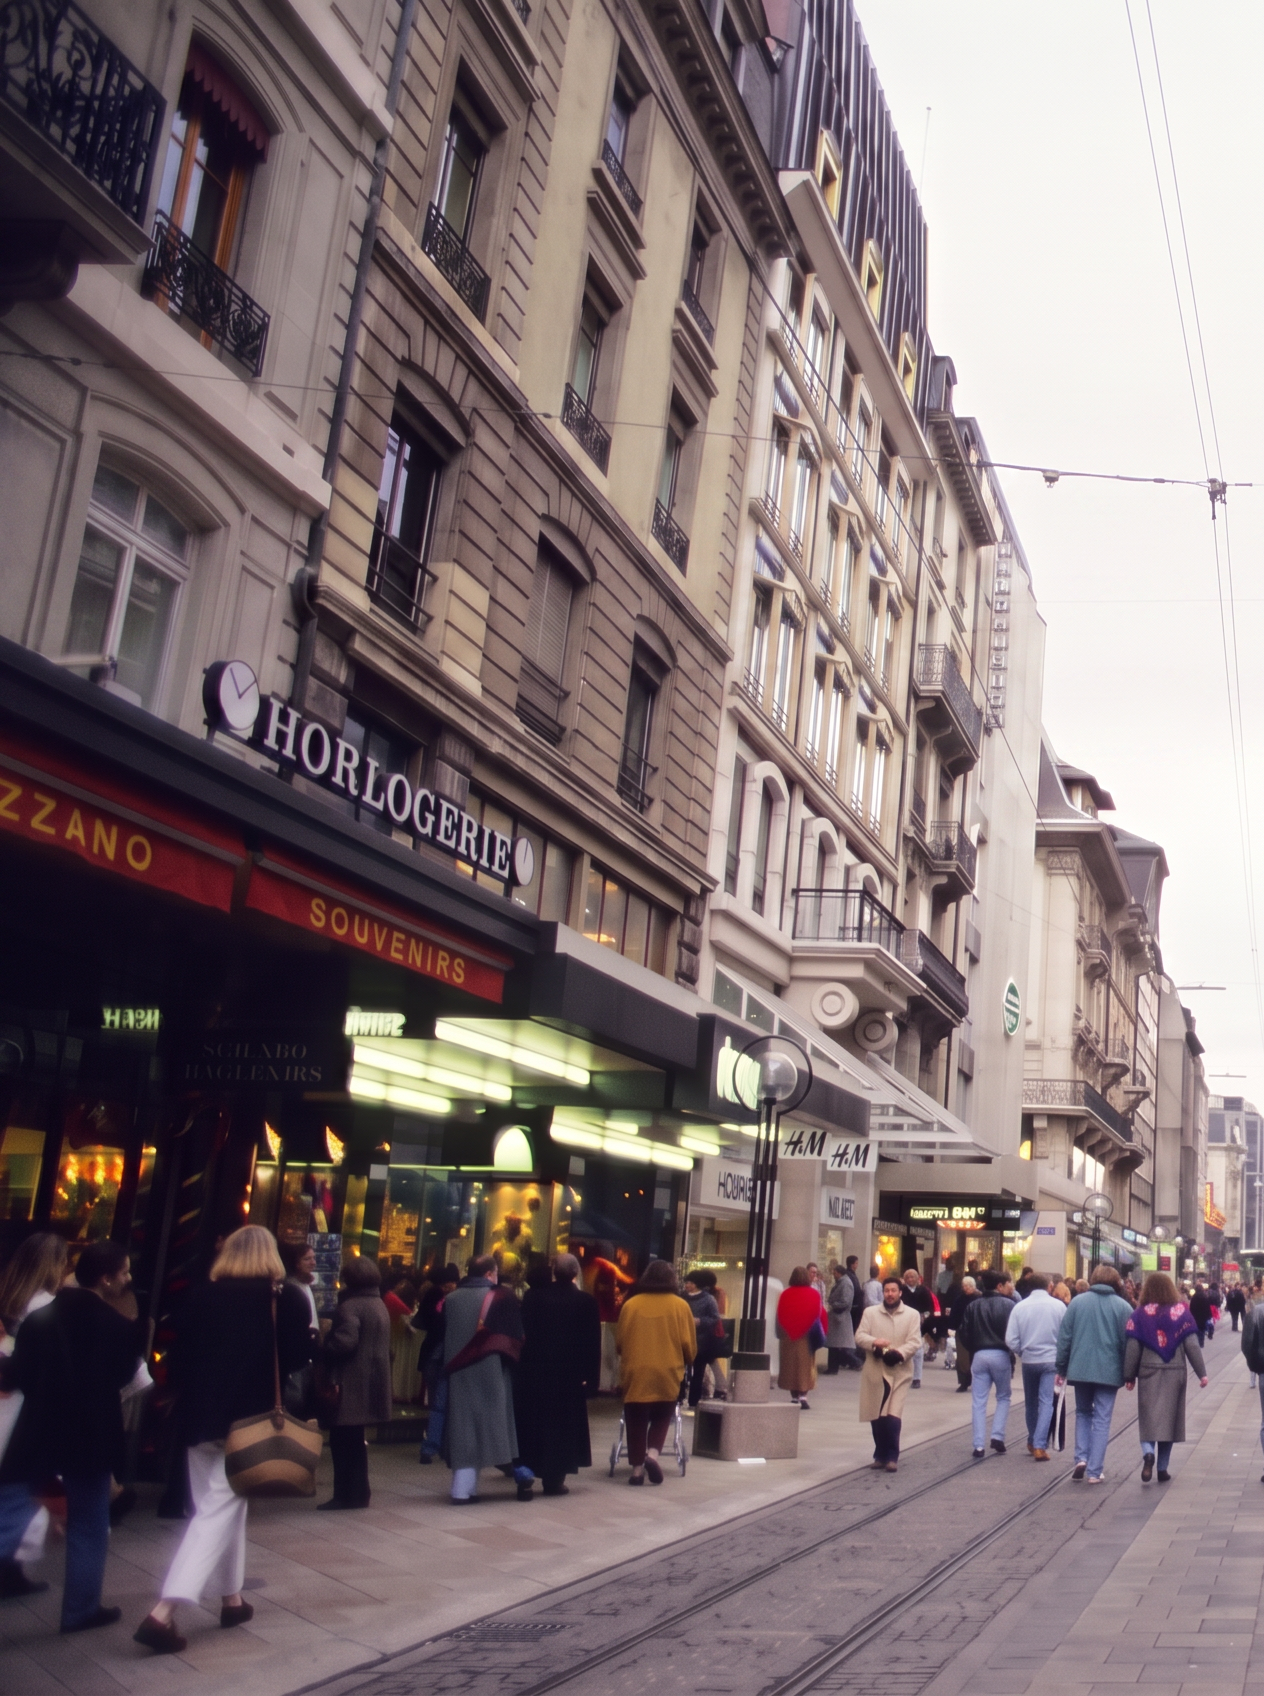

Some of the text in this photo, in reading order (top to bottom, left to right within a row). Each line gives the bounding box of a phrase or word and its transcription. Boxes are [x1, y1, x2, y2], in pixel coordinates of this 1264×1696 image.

[0, 777, 152, 871] ZZANO
[264, 695, 511, 880] HORLOGERIE
[310, 898, 465, 984] SOUVENIRS
